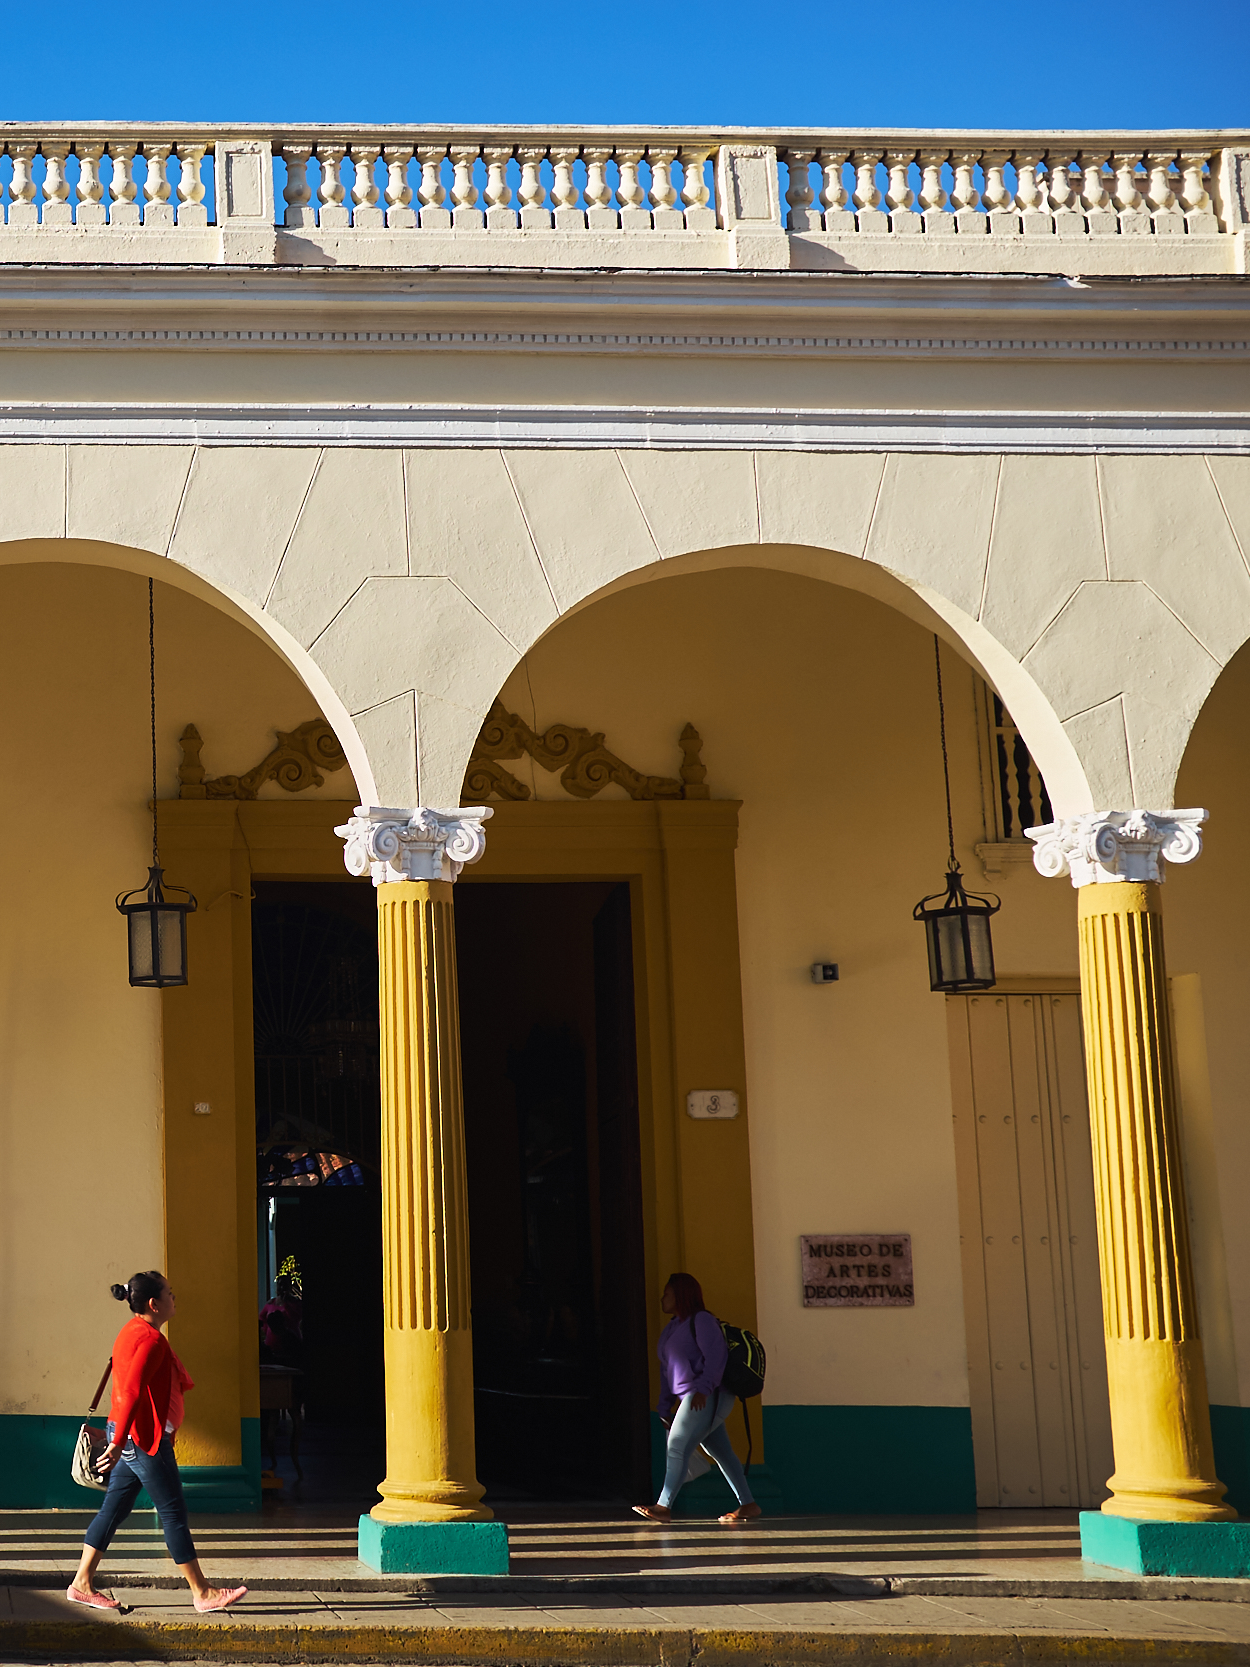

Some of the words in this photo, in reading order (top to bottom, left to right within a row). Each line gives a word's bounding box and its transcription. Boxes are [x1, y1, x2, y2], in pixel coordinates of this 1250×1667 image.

[707, 1095, 720, 1114] 3
[809, 1244, 872, 1258] MUSEO
[878, 1243, 904, 1257] DE
[826, 1264, 891, 1278] ARTES
[804, 1284, 914, 1299] DECORATIVAS
